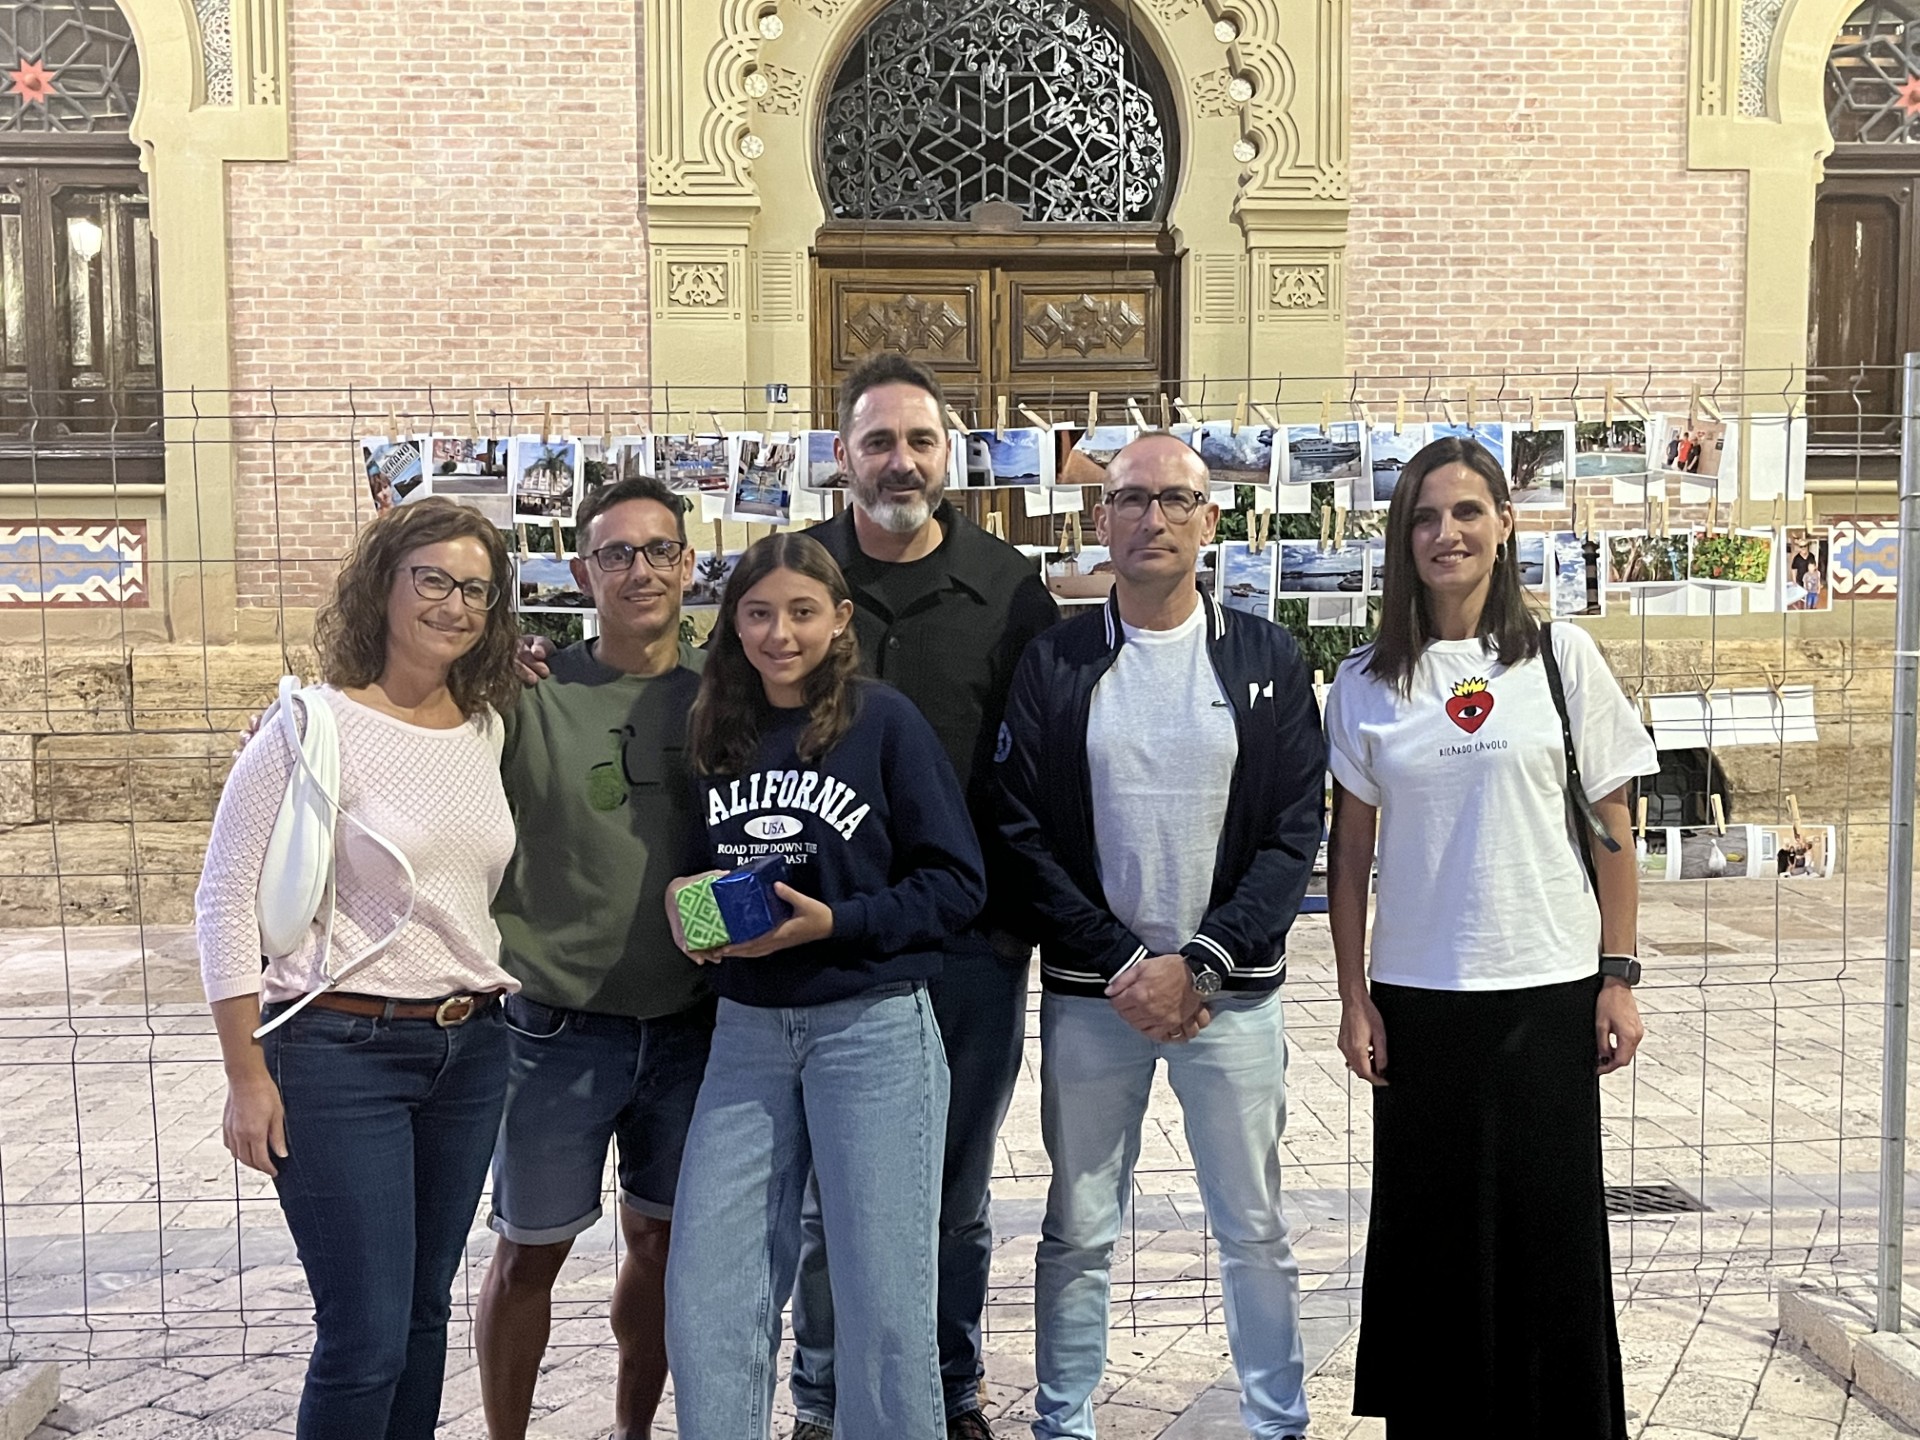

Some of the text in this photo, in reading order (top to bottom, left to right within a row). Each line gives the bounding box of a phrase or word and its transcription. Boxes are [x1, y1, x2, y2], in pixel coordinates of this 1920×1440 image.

[769, 384, 787, 402] 14
[381, 444, 410, 474] VERANO
[1439, 740, 1508, 757] RICARDO CAVOLO
[706, 770, 871, 841] ALIFORNIA
[762, 821, 786, 835] USA
[717, 843, 747, 855] ROAD
[748, 843, 769, 855] TRIP
[769, 842, 802, 854] DOWN
